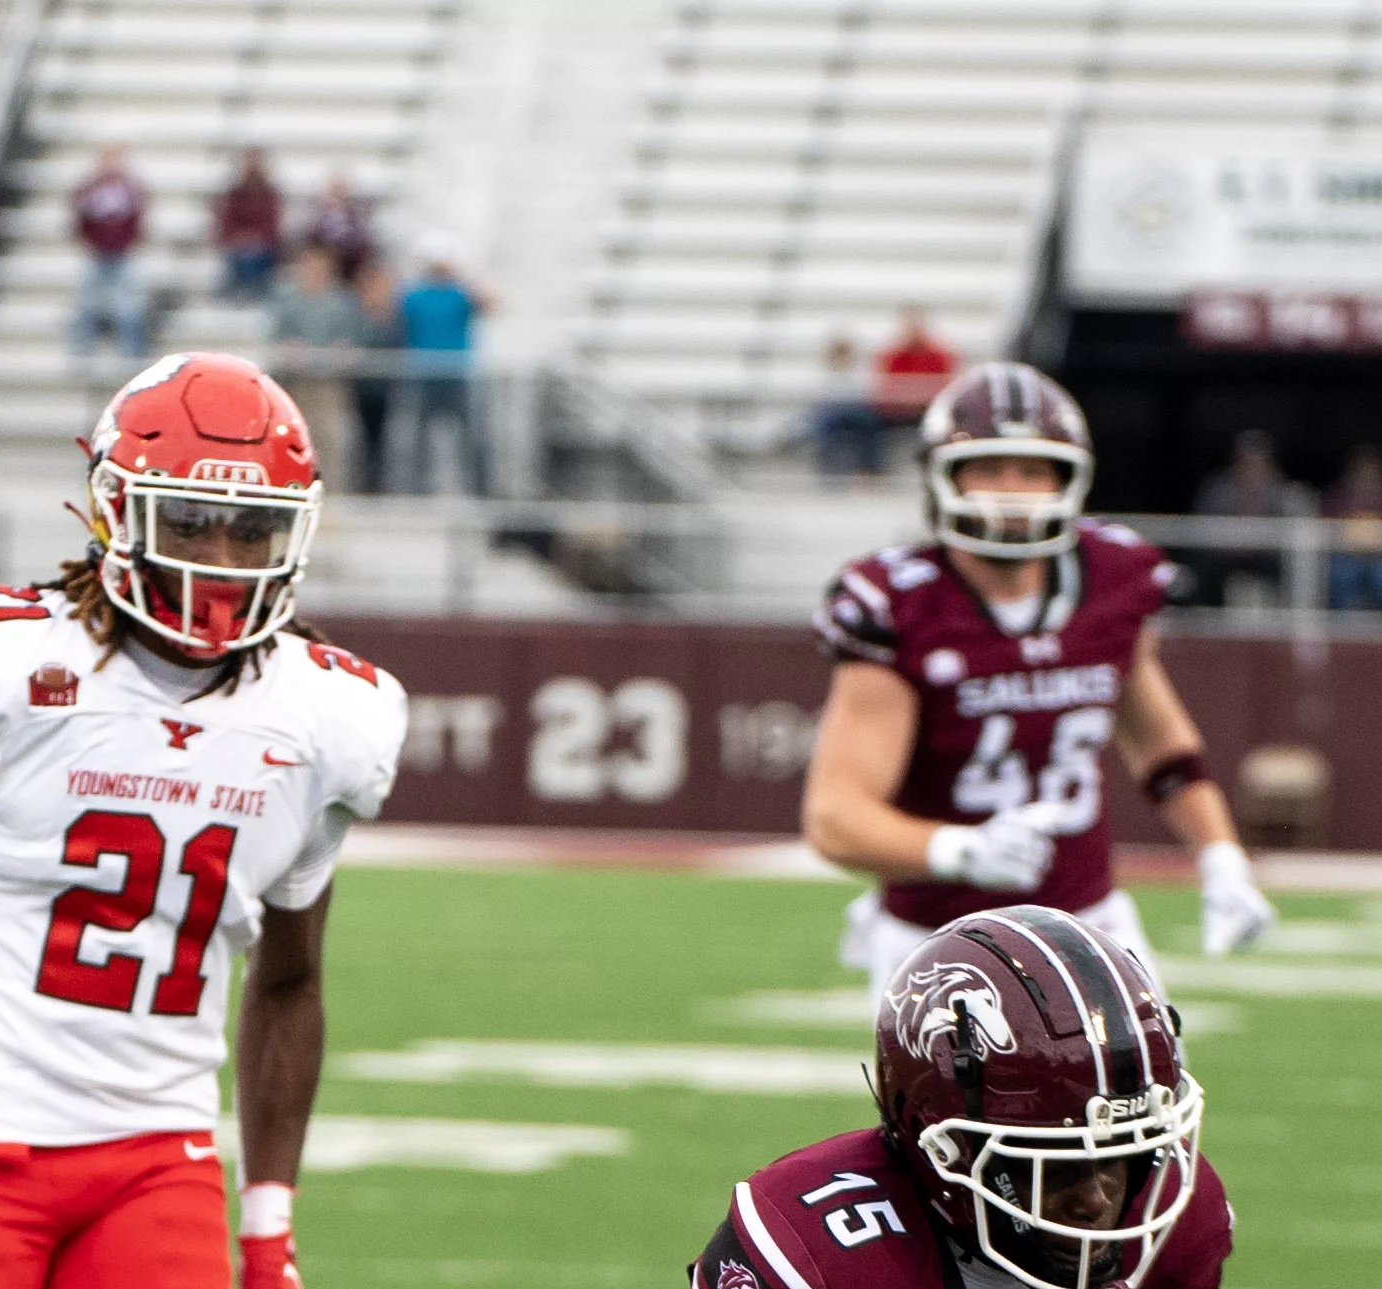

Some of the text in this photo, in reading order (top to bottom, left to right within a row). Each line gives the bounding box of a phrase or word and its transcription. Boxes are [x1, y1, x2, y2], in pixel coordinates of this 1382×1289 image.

[160, 717, 205, 751] Y
[527, 677, 691, 804] 23
[952, 705, 1115, 837] 46
[66, 769, 269, 818] YOUNGSTOWN STATE
[36, 809, 240, 1017] 21
[799, 1171, 909, 1249] 15
